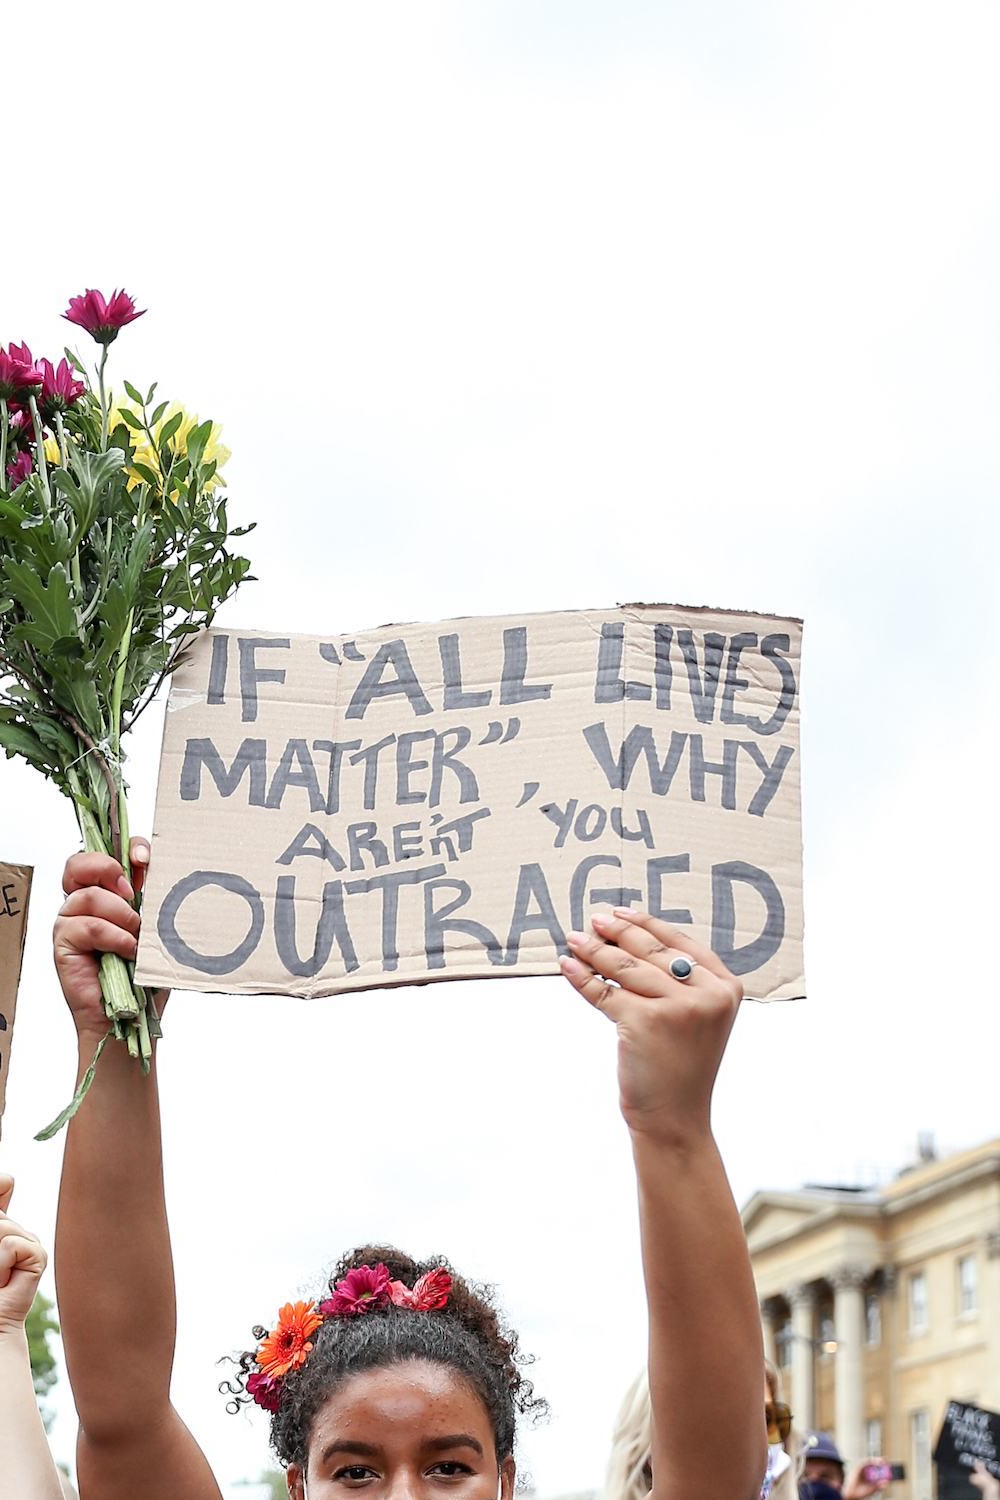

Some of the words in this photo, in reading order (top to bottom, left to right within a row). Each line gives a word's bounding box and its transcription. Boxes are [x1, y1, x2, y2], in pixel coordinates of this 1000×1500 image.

[206, 635, 290, 722] IF
[319, 626, 553, 720] "ALL
[594, 622, 797, 736] LIVES
[582, 721, 795, 817] WHY
[538, 798, 656, 849] YOU
[157, 853, 786, 977] OUTRAGED
